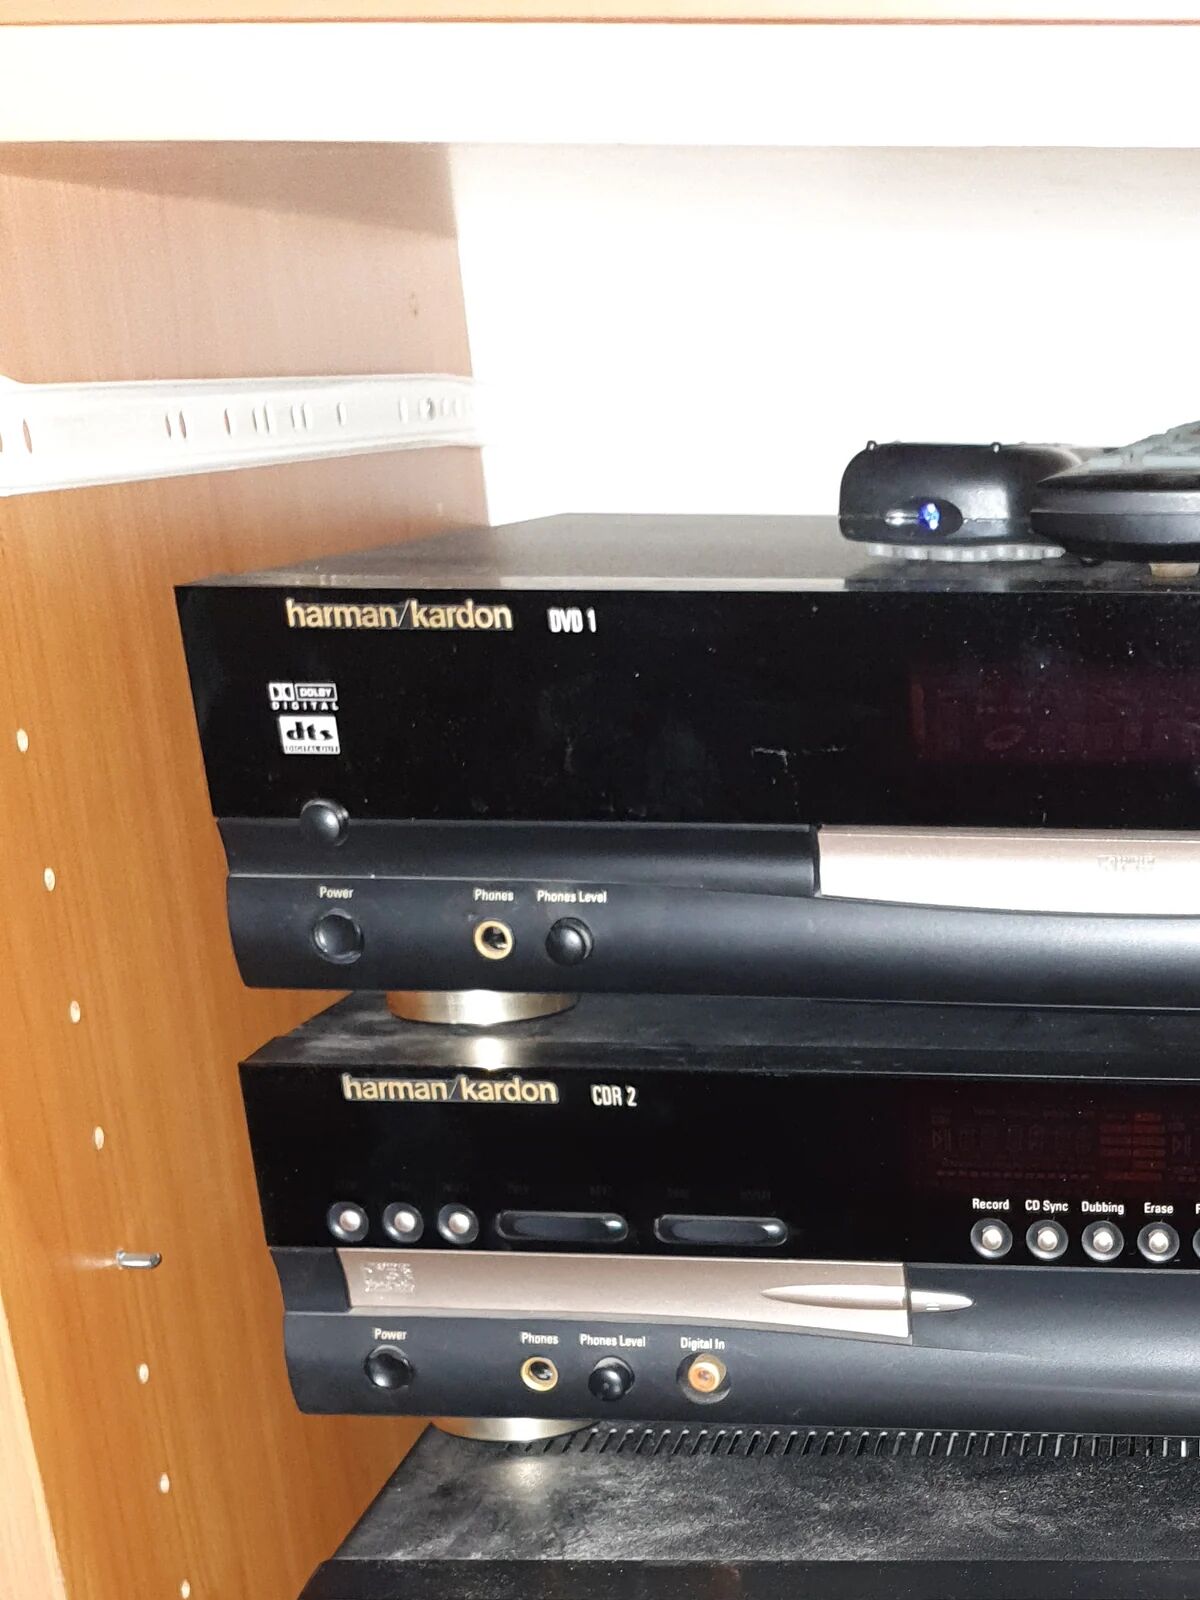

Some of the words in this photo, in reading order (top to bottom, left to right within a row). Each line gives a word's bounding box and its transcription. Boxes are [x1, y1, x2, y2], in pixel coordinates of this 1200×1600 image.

[285, 598, 513, 629] harman/kardon
[549, 608, 583, 633] DVD
[587, 607, 597, 633] 1
[299, 687, 332, 698] DOLBY
[271, 701, 339, 711] DIGITAL
[286, 721, 333, 741] dts
[319, 886, 354, 899] Power
[475, 889, 513, 902] Phones
[536, 890, 576, 903] Phones
[578, 891, 606, 904] Level
[342, 1074, 558, 1102] harman/kardon
[591, 1085, 623, 1106] CDR
[626, 1085, 637, 1107] 2
[972, 1198, 1010, 1211] Record
[1025, 1200, 1040, 1212] CD
[1043, 1200, 1069, 1215] Sync
[1081, 1201, 1125, 1216] Dubbing
[1144, 1202, 1174, 1215] Erase
[374, 1328, 408, 1341] Power
[521, 1333, 559, 1345] Phones
[579, 1334, 618, 1347] Phones
[620, 1335, 646, 1348] Level
[680, 1337, 713, 1351] Digital
[714, 1338, 725, 1351] In
